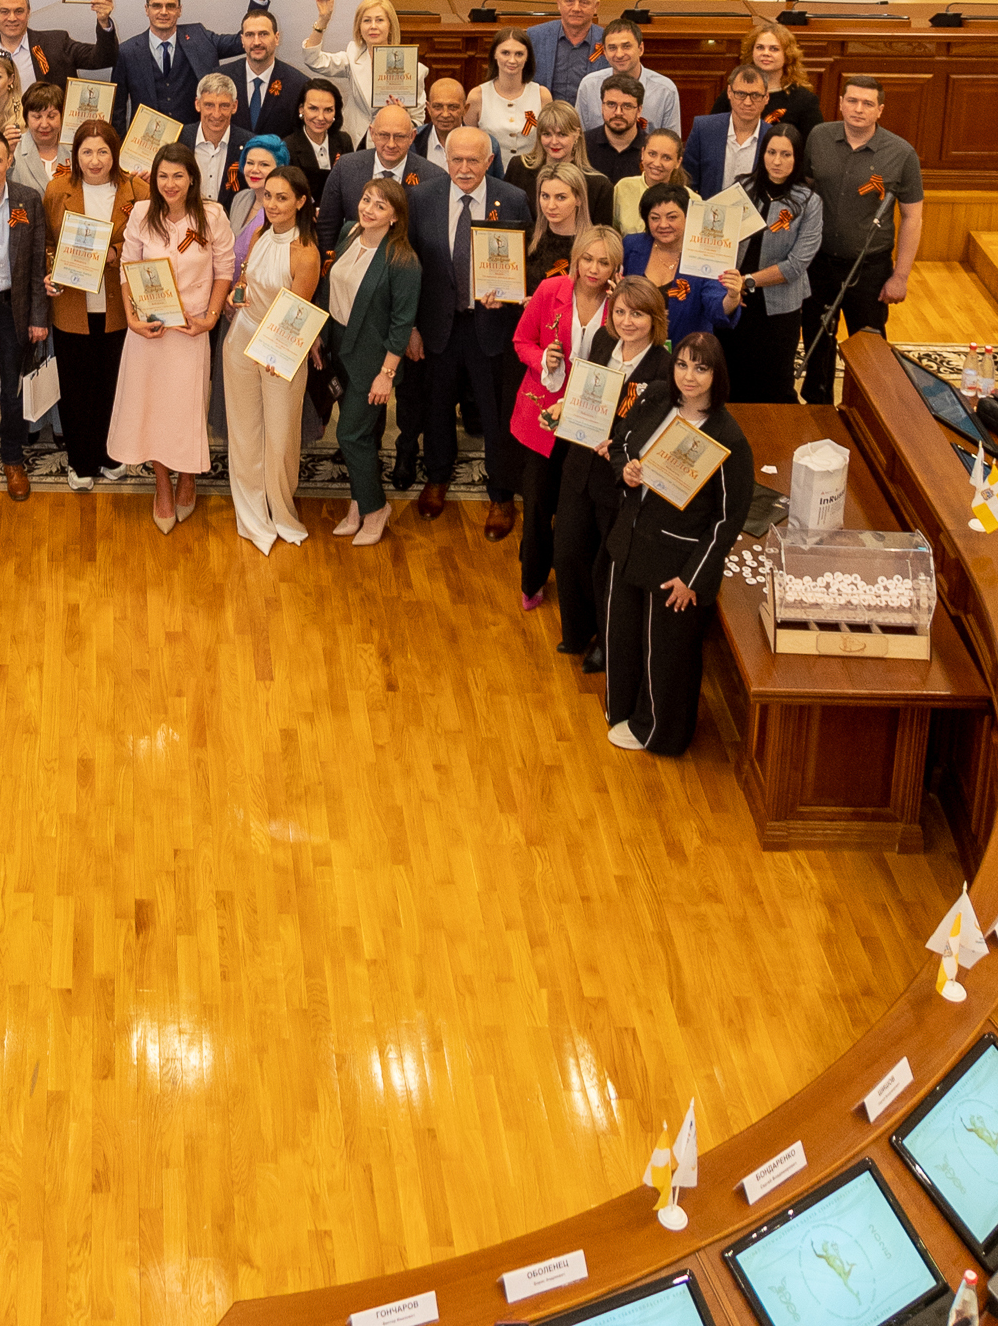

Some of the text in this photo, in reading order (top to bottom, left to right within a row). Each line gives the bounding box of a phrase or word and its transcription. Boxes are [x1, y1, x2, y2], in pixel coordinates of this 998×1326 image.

[131, 136, 160, 152] ДИПЛО
[690, 235, 732, 248] ДИПЛОМ
[63, 246, 100, 261] ДИПЛОМ
[479, 262, 518, 271] ДИПЛОМ
[570, 397, 608, 416] ДИПЛОМ
[656, 449, 699, 480] ДИПЛОМ
[755, 1149, 796, 1181] БОНДАРЕНКО
[527, 1260, 569, 1279] ОБОЛЕНЕЦ
[376, 1301, 418, 1318] ГОНЧАРОВ
